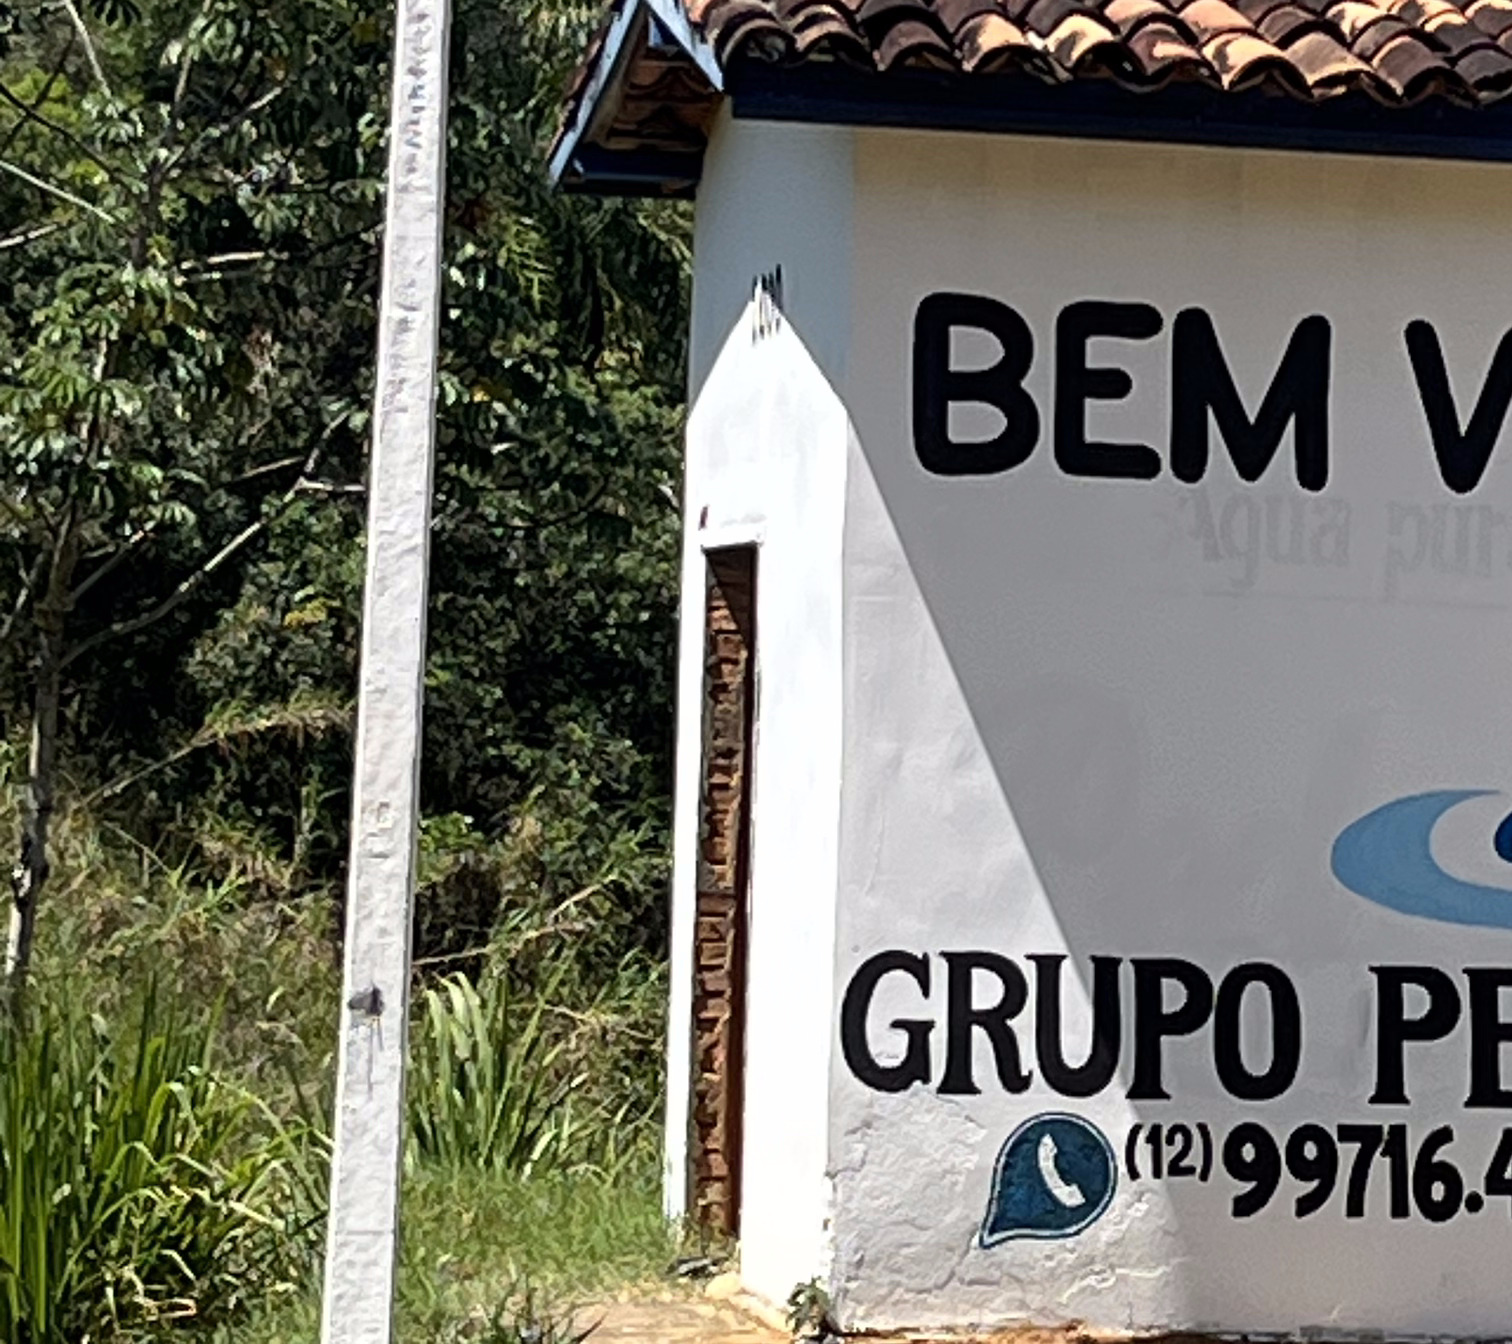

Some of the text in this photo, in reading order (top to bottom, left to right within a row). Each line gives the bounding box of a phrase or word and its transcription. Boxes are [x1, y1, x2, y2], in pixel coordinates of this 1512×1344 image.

[913, 292, 1331, 491] BEM
[841, 950, 1301, 1101] GRUPO
[1126, 1122, 1212, 1182] (12)
